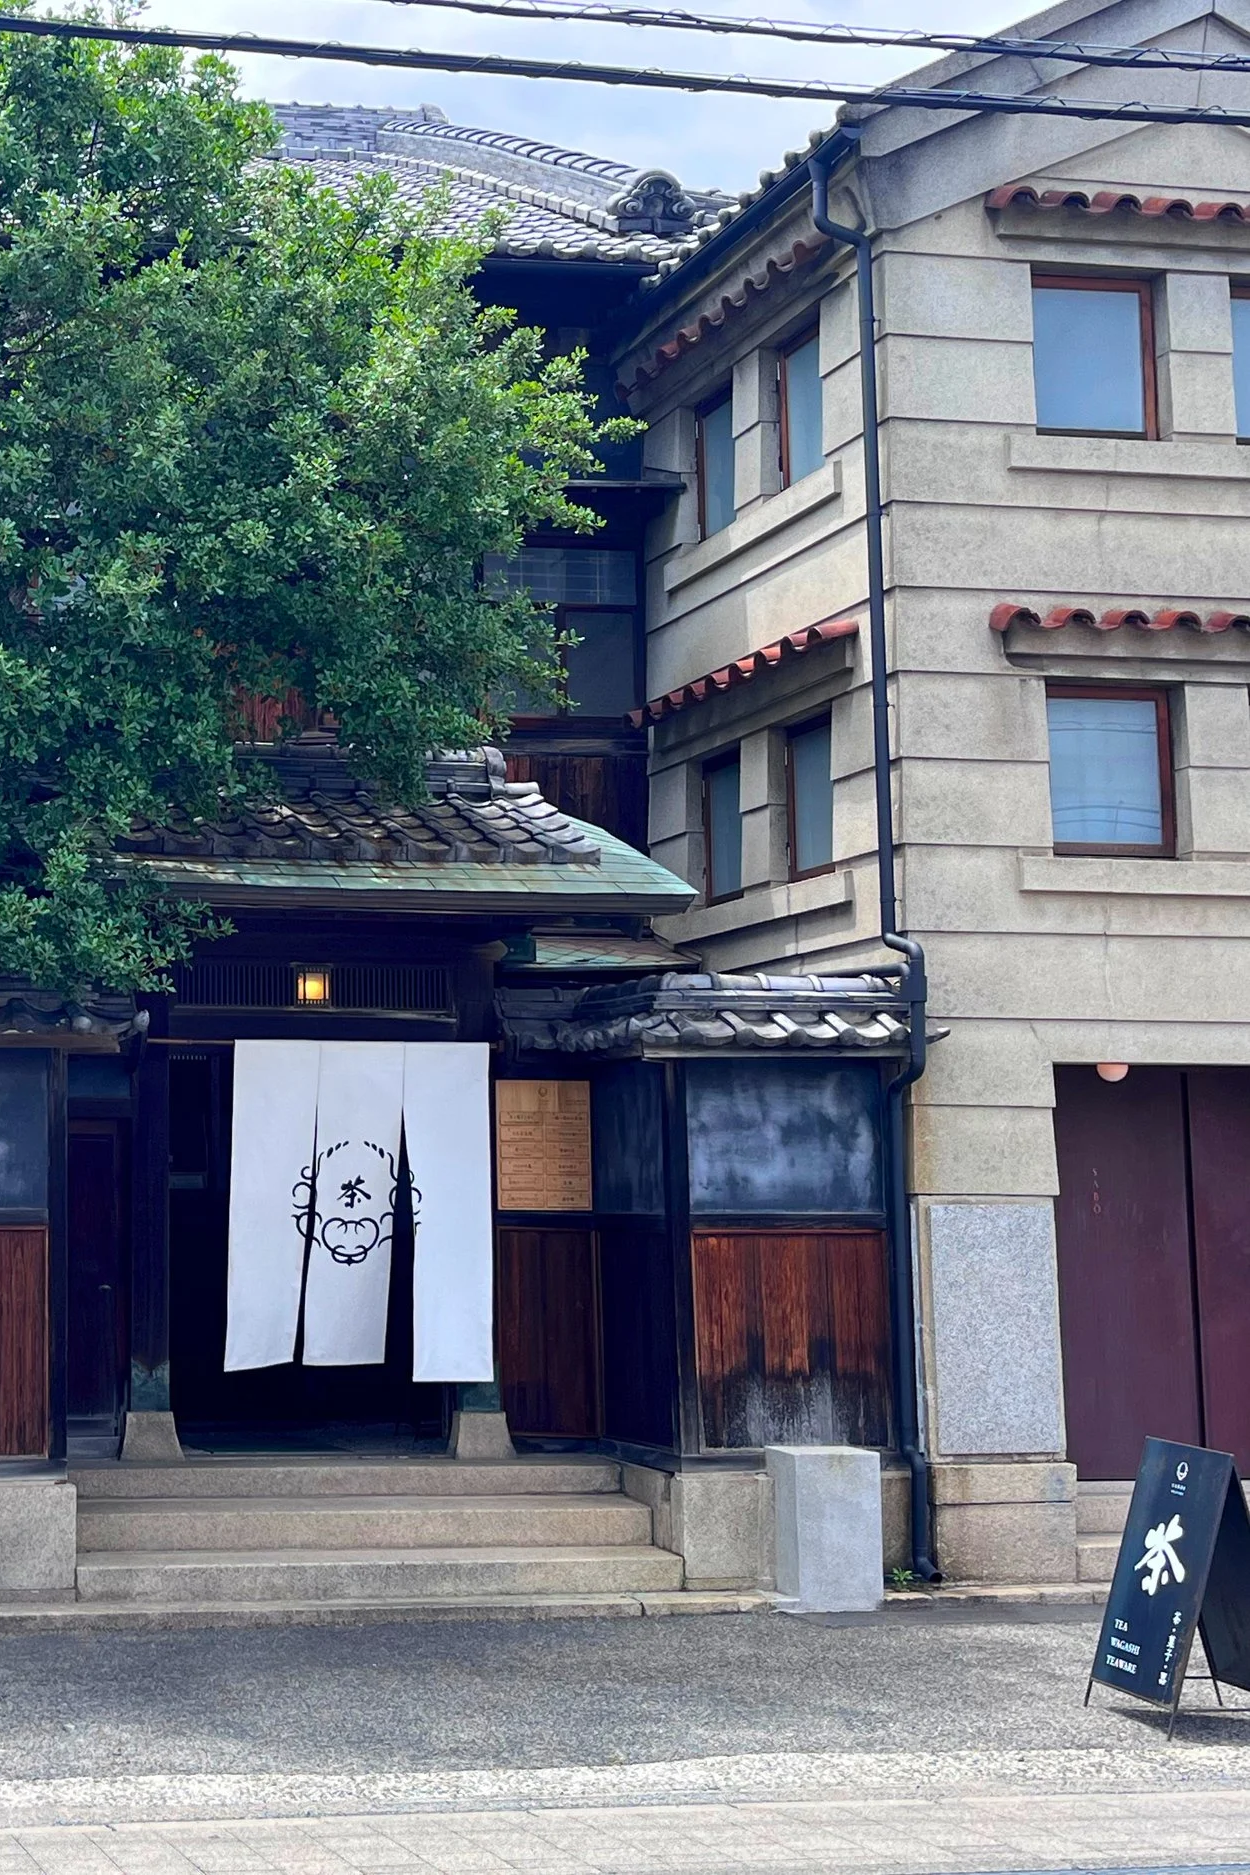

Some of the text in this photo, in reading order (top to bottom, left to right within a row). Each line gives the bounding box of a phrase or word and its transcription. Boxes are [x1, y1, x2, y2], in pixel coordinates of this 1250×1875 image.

[336, 1175, 372, 1209] 茶
[1134, 1513, 1186, 1597] 茶
[1114, 1618, 1128, 1632] TEA
[1110, 1636, 1141, 1656] WAGASHI
[1106, 1654, 1138, 1675] TEAWARE
